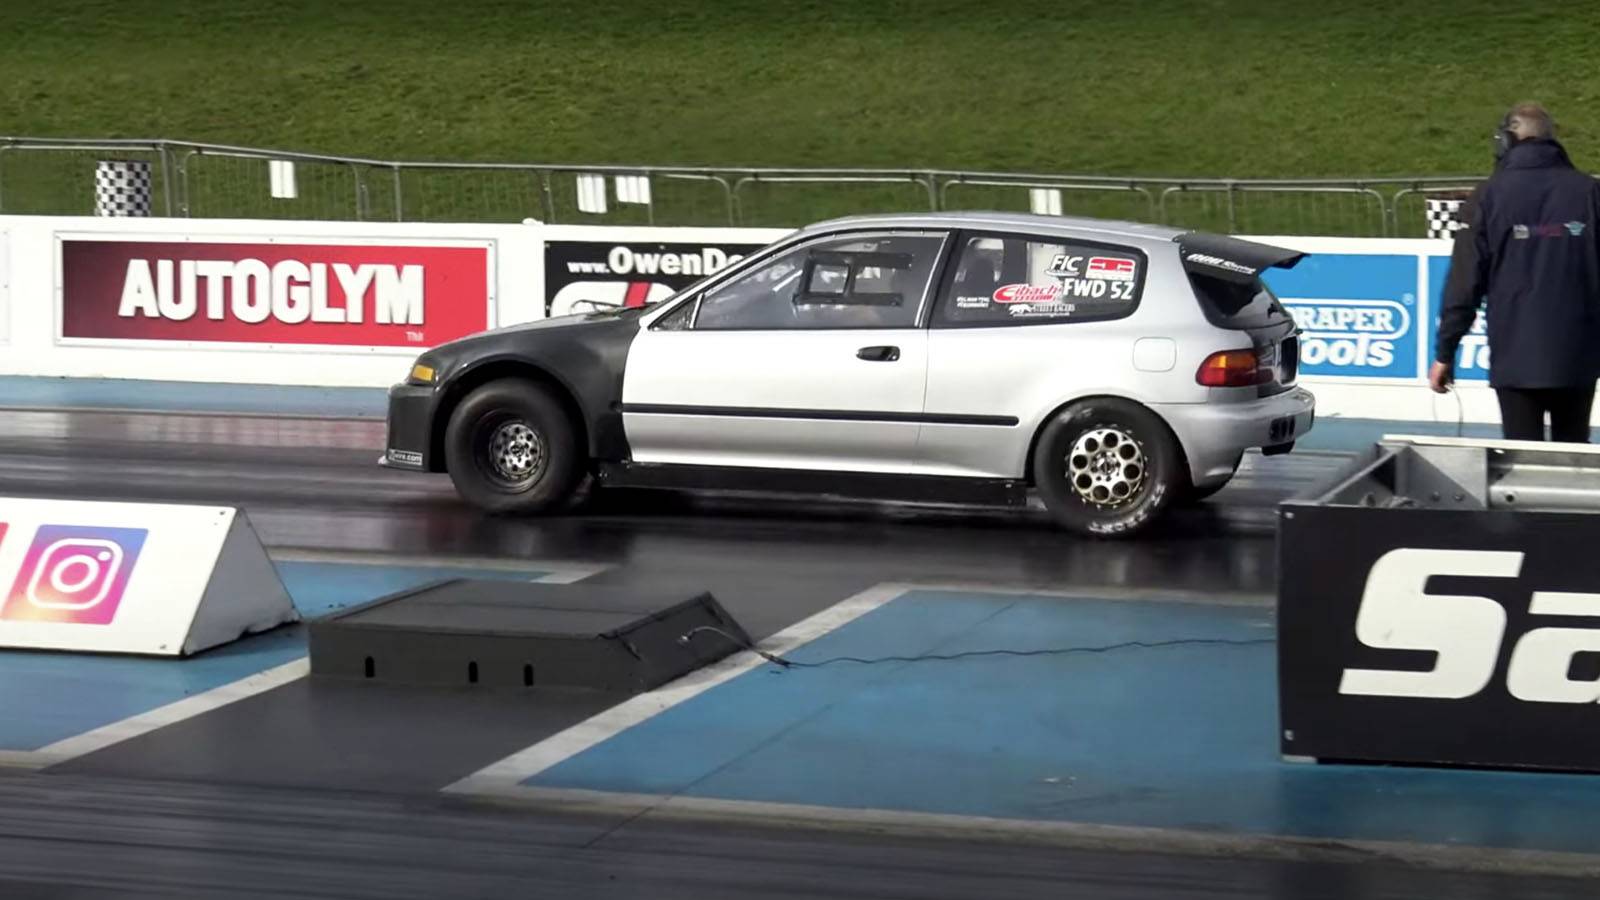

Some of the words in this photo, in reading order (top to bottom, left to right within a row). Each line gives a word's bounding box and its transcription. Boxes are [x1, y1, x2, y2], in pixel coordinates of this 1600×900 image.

[1051, 255, 1083, 272] FIC
[118, 258, 424, 325] AUTOGLYM
[1063, 278, 1106, 298] FWD
[1110, 281, 1135, 300] 52
